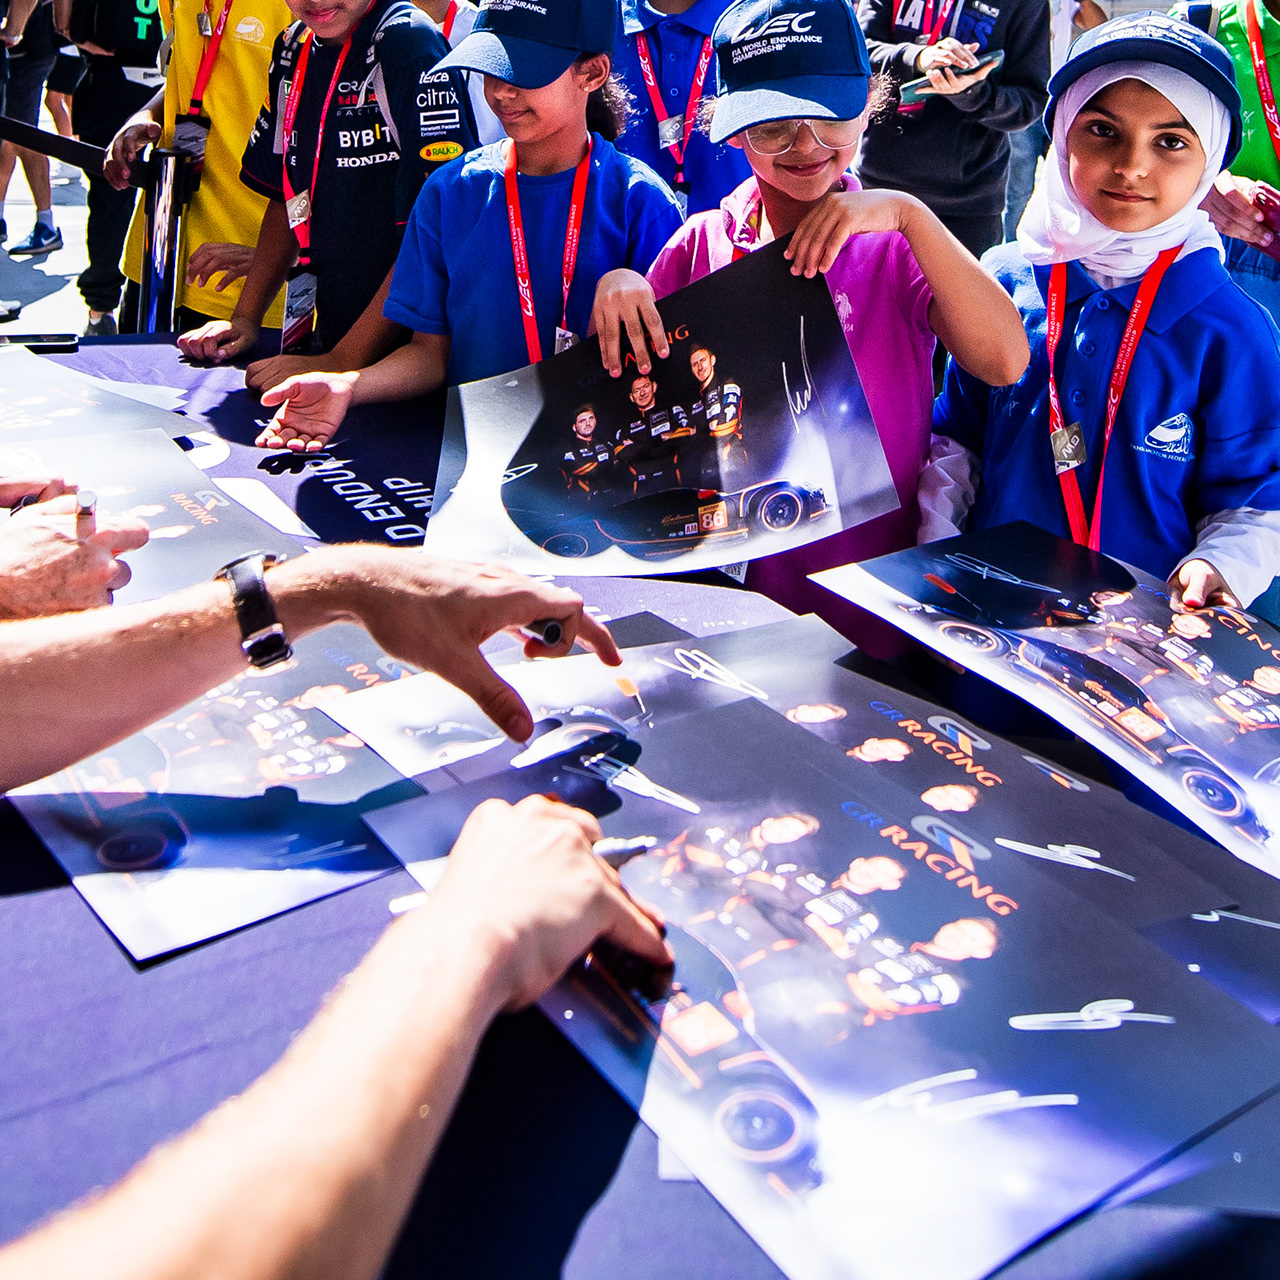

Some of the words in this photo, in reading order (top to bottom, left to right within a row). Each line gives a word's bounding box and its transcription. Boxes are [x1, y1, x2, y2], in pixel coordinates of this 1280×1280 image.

[503, 0, 548, 16] ENDURANCE
[729, 10, 817, 45] WEC
[742, 39, 768, 54] WORLD
[770, 34, 823, 44] ENDURANCE
[696, 51, 710, 87] WEC
[732, 43, 787, 65] CHAMPIONSHIP
[639, 55, 655, 87] WEC
[416, 87, 460, 108] citrix
[339, 123, 392, 148] BYBIT
[432, 146, 459, 157] RAUCH
[336, 151, 401, 168] HONDA
[509, 204, 518, 241] ENDURANCE
[518, 276, 533, 317] WEC
[1050, 292, 1058, 336] ENDURANCE
[1111, 370, 1120, 385] FIA
[1116, 339, 1128, 370] WORLD
[1124, 299, 1143, 339] ENDURANCE
[1117, 329, 1137, 387] CHAMPIONSHIP
[170, 493, 219, 526] RACING
[702, 510, 726, 529] 86
[870, 701, 904, 722] GR
[897, 719, 1003, 788] RACING
[841, 801, 884, 830] GR
[879, 824, 1019, 917] RACING
